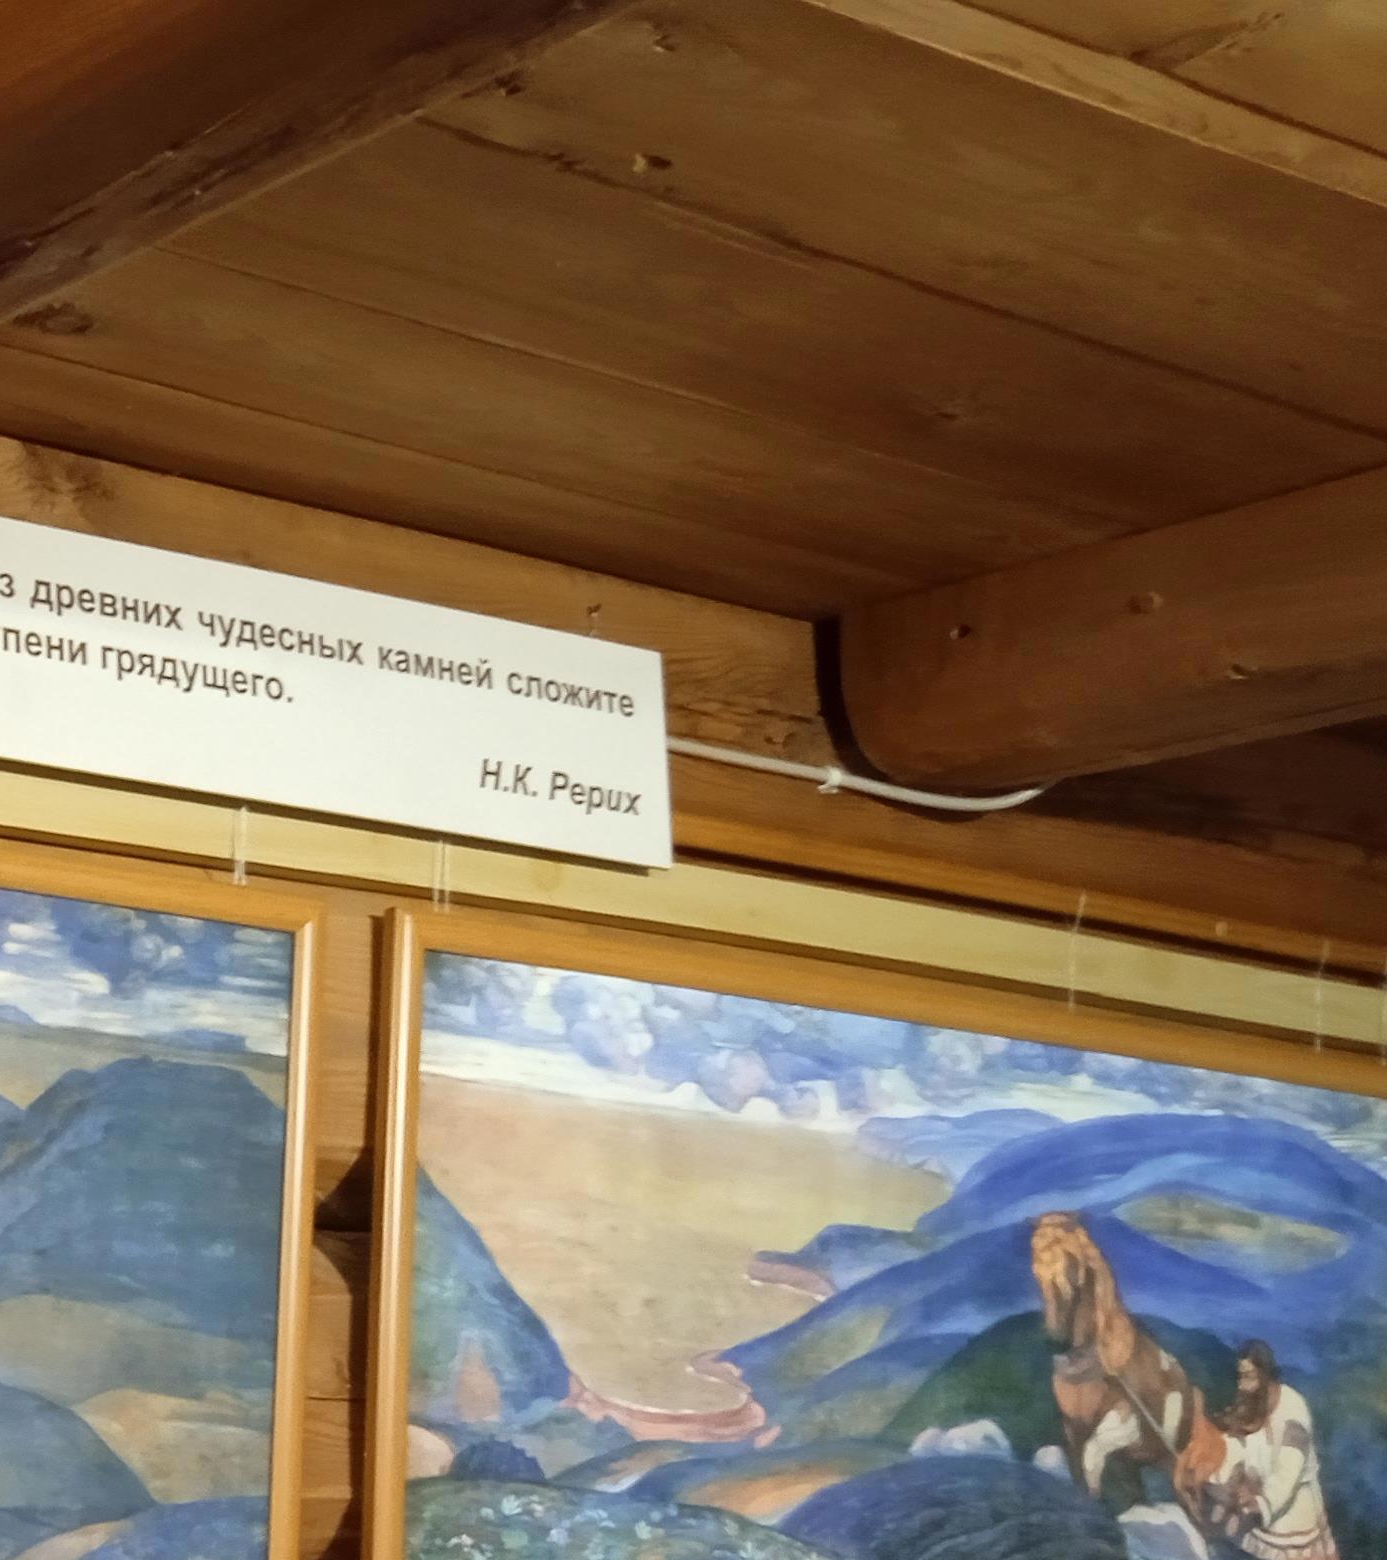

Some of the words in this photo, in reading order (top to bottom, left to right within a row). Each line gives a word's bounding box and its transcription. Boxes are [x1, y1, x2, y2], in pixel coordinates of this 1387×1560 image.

[29, 579, 184, 631] древних
[197, 610, 364, 666] чудесных
[377, 645, 494, 690] камней
[506, 671, 635, 718] сложите
[100, 645, 294, 704] грядущего.
[479, 758, 538, 798] Н.К.
[548, 770, 642, 816] Рерих
